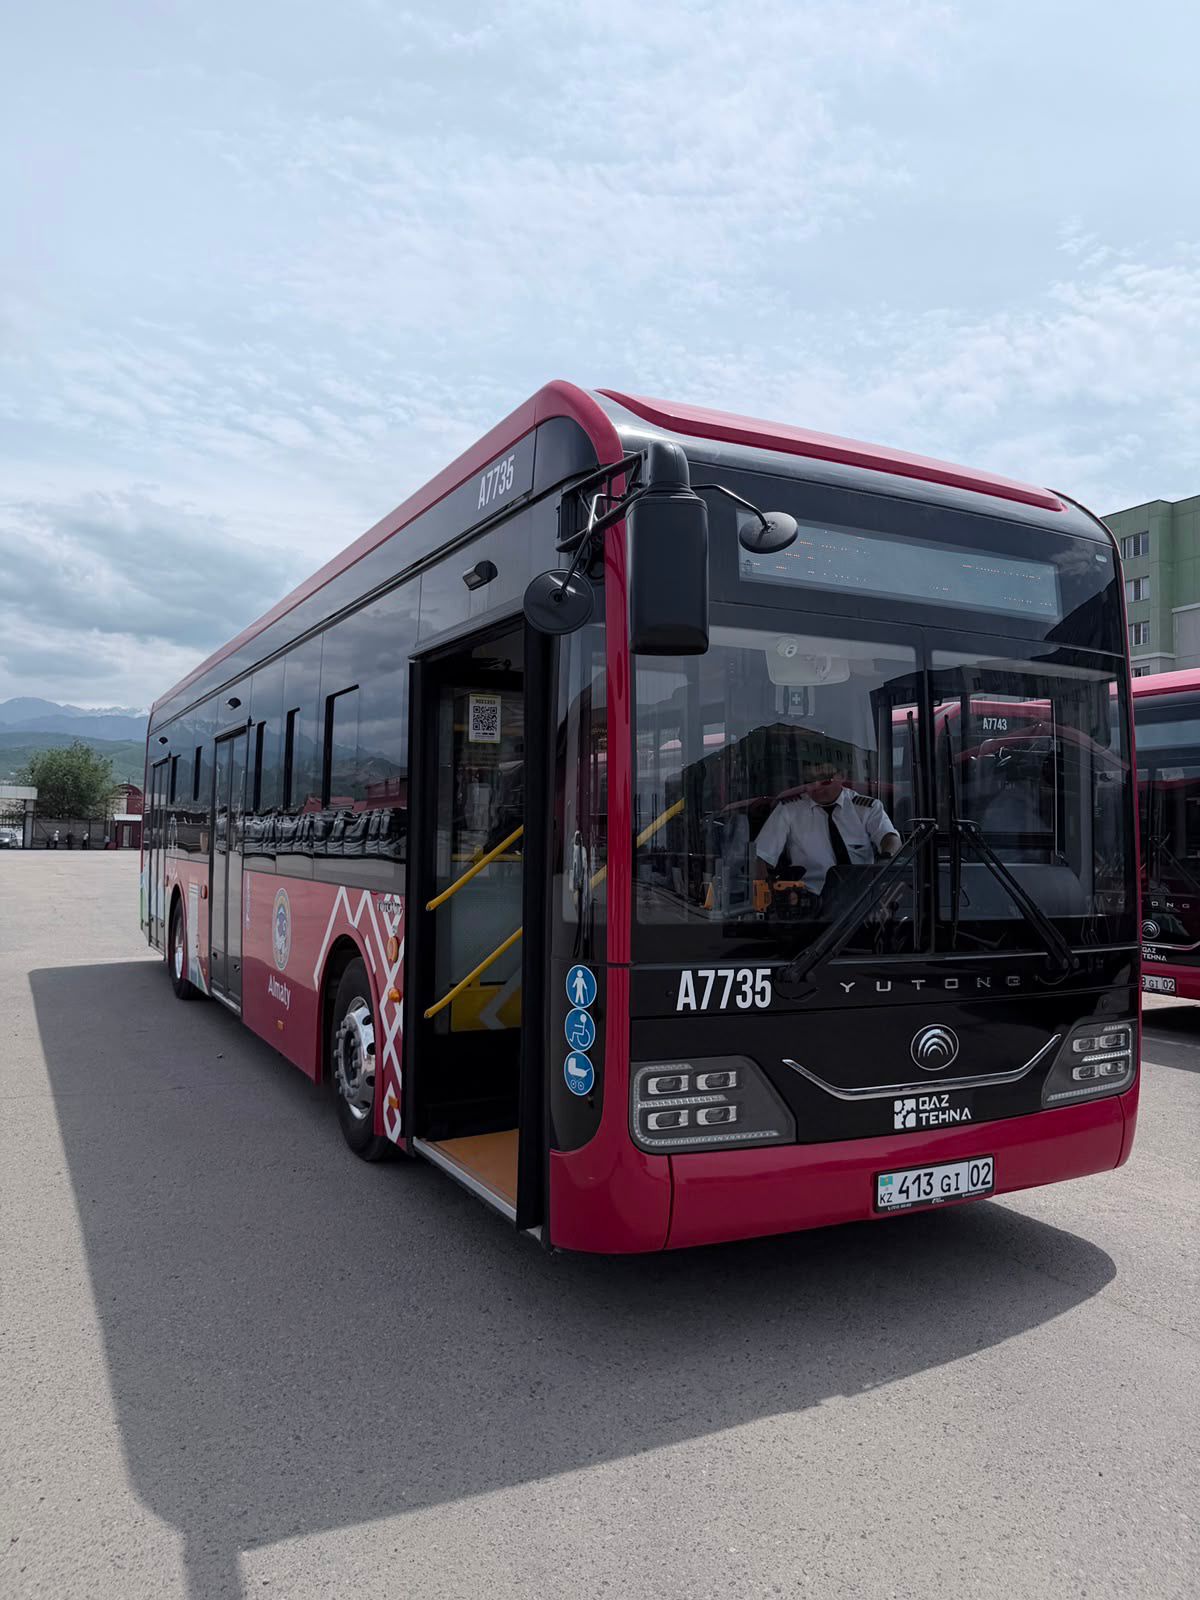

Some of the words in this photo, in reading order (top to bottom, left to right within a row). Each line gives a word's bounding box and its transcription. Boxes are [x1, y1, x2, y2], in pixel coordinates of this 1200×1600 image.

[478, 454, 515, 510] A7735
[982, 717, 1008, 730] A7743
[1151, 901, 1190, 909] ONG
[268, 974, 291, 1010] Almaty
[676, 968, 772, 1011] A7735
[840, 975, 1021, 993] YUTONG
[1163, 979, 1175, 991] 02
[919, 1094, 949, 1110] QAZ
[919, 1107, 972, 1126] TEHNA
[880, 1192, 893, 1204] KZ
[898, 1171, 935, 1200] 413
[940, 1172, 961, 1193] GI
[970, 1162, 992, 1188] 02
